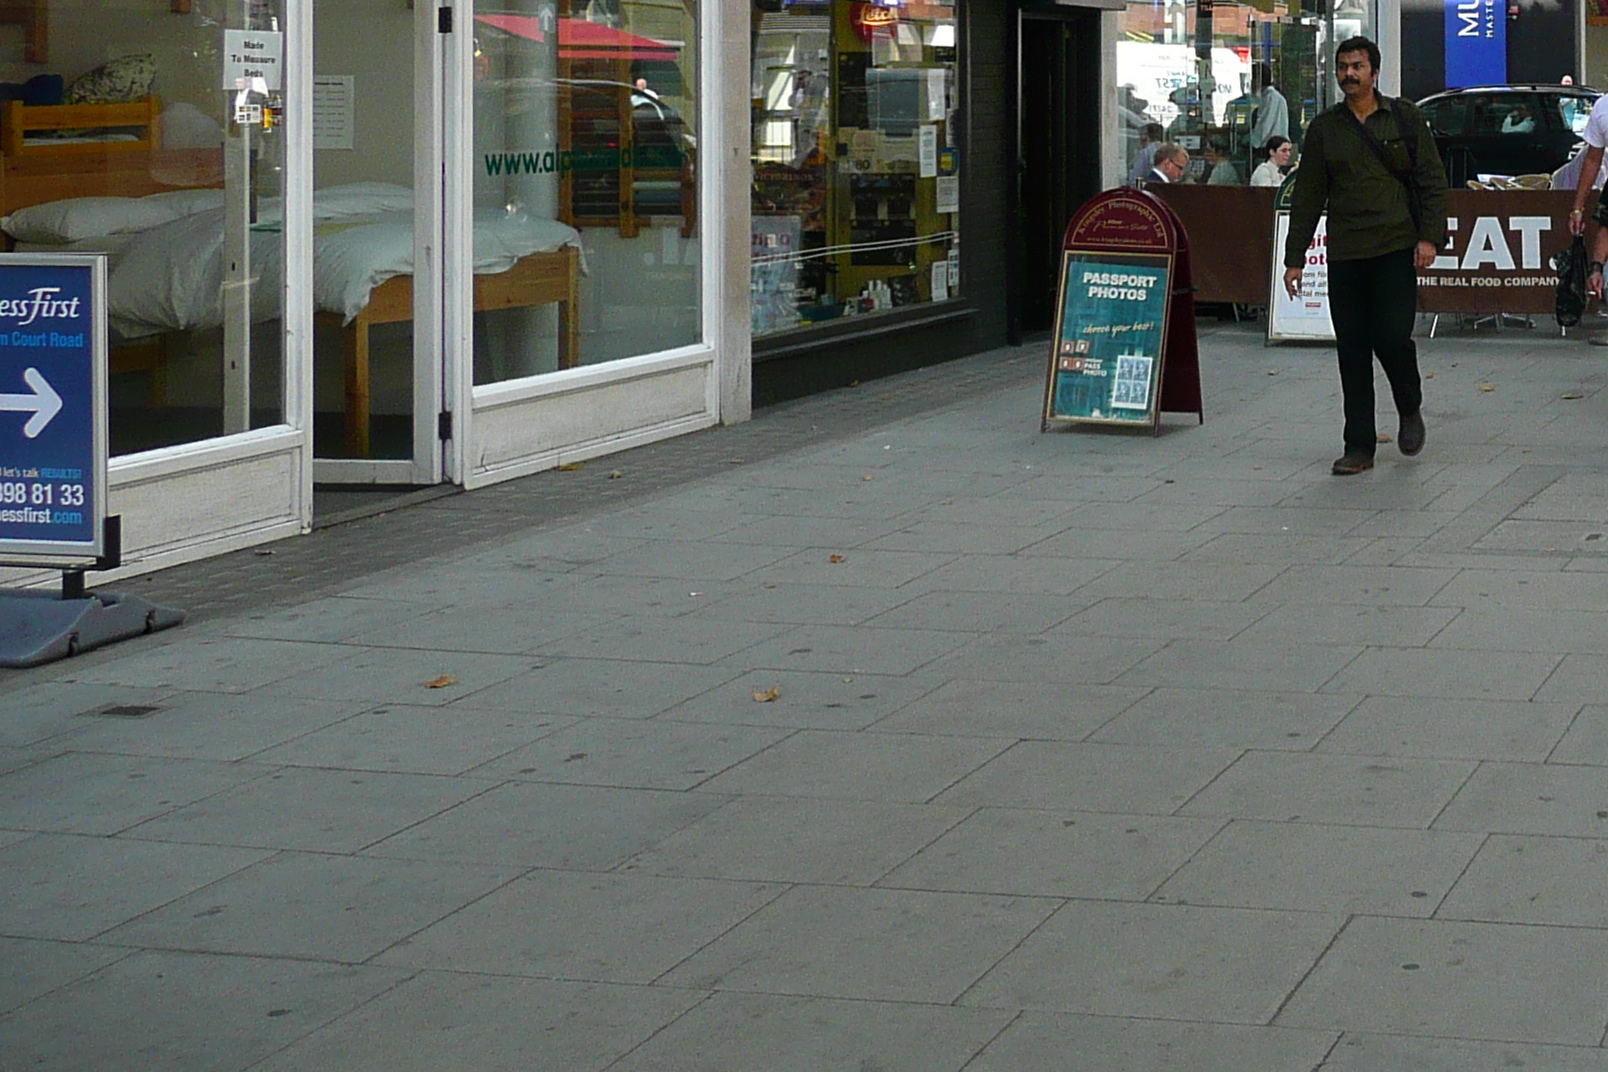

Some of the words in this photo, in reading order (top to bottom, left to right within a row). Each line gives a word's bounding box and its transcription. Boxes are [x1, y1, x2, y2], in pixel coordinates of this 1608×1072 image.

[243, 41, 265, 49] Made
[231, 54, 242, 63] To
[243, 55, 276, 64] Measure
[244, 69, 264, 77] Beds
[1082, 272, 1157, 288] PASSPORT
[1416, 277, 1438, 286] THE
[1440, 277, 1468, 286] REAL
[1471, 277, 1501, 287] FOOD
[1087, 286, 1147, 301] PHOTOS
[12, 331, 47, 347] Court
[50, 332, 84, 348] Road
[3, 467, 21, 477] let's
[22, 468, 39, 478] talk
[0, 482, 27, 504] 98
[31, 483, 53, 505] 81
[60, 484, 84, 506] 33
[0, 507, 82, 525] essfirst.com
